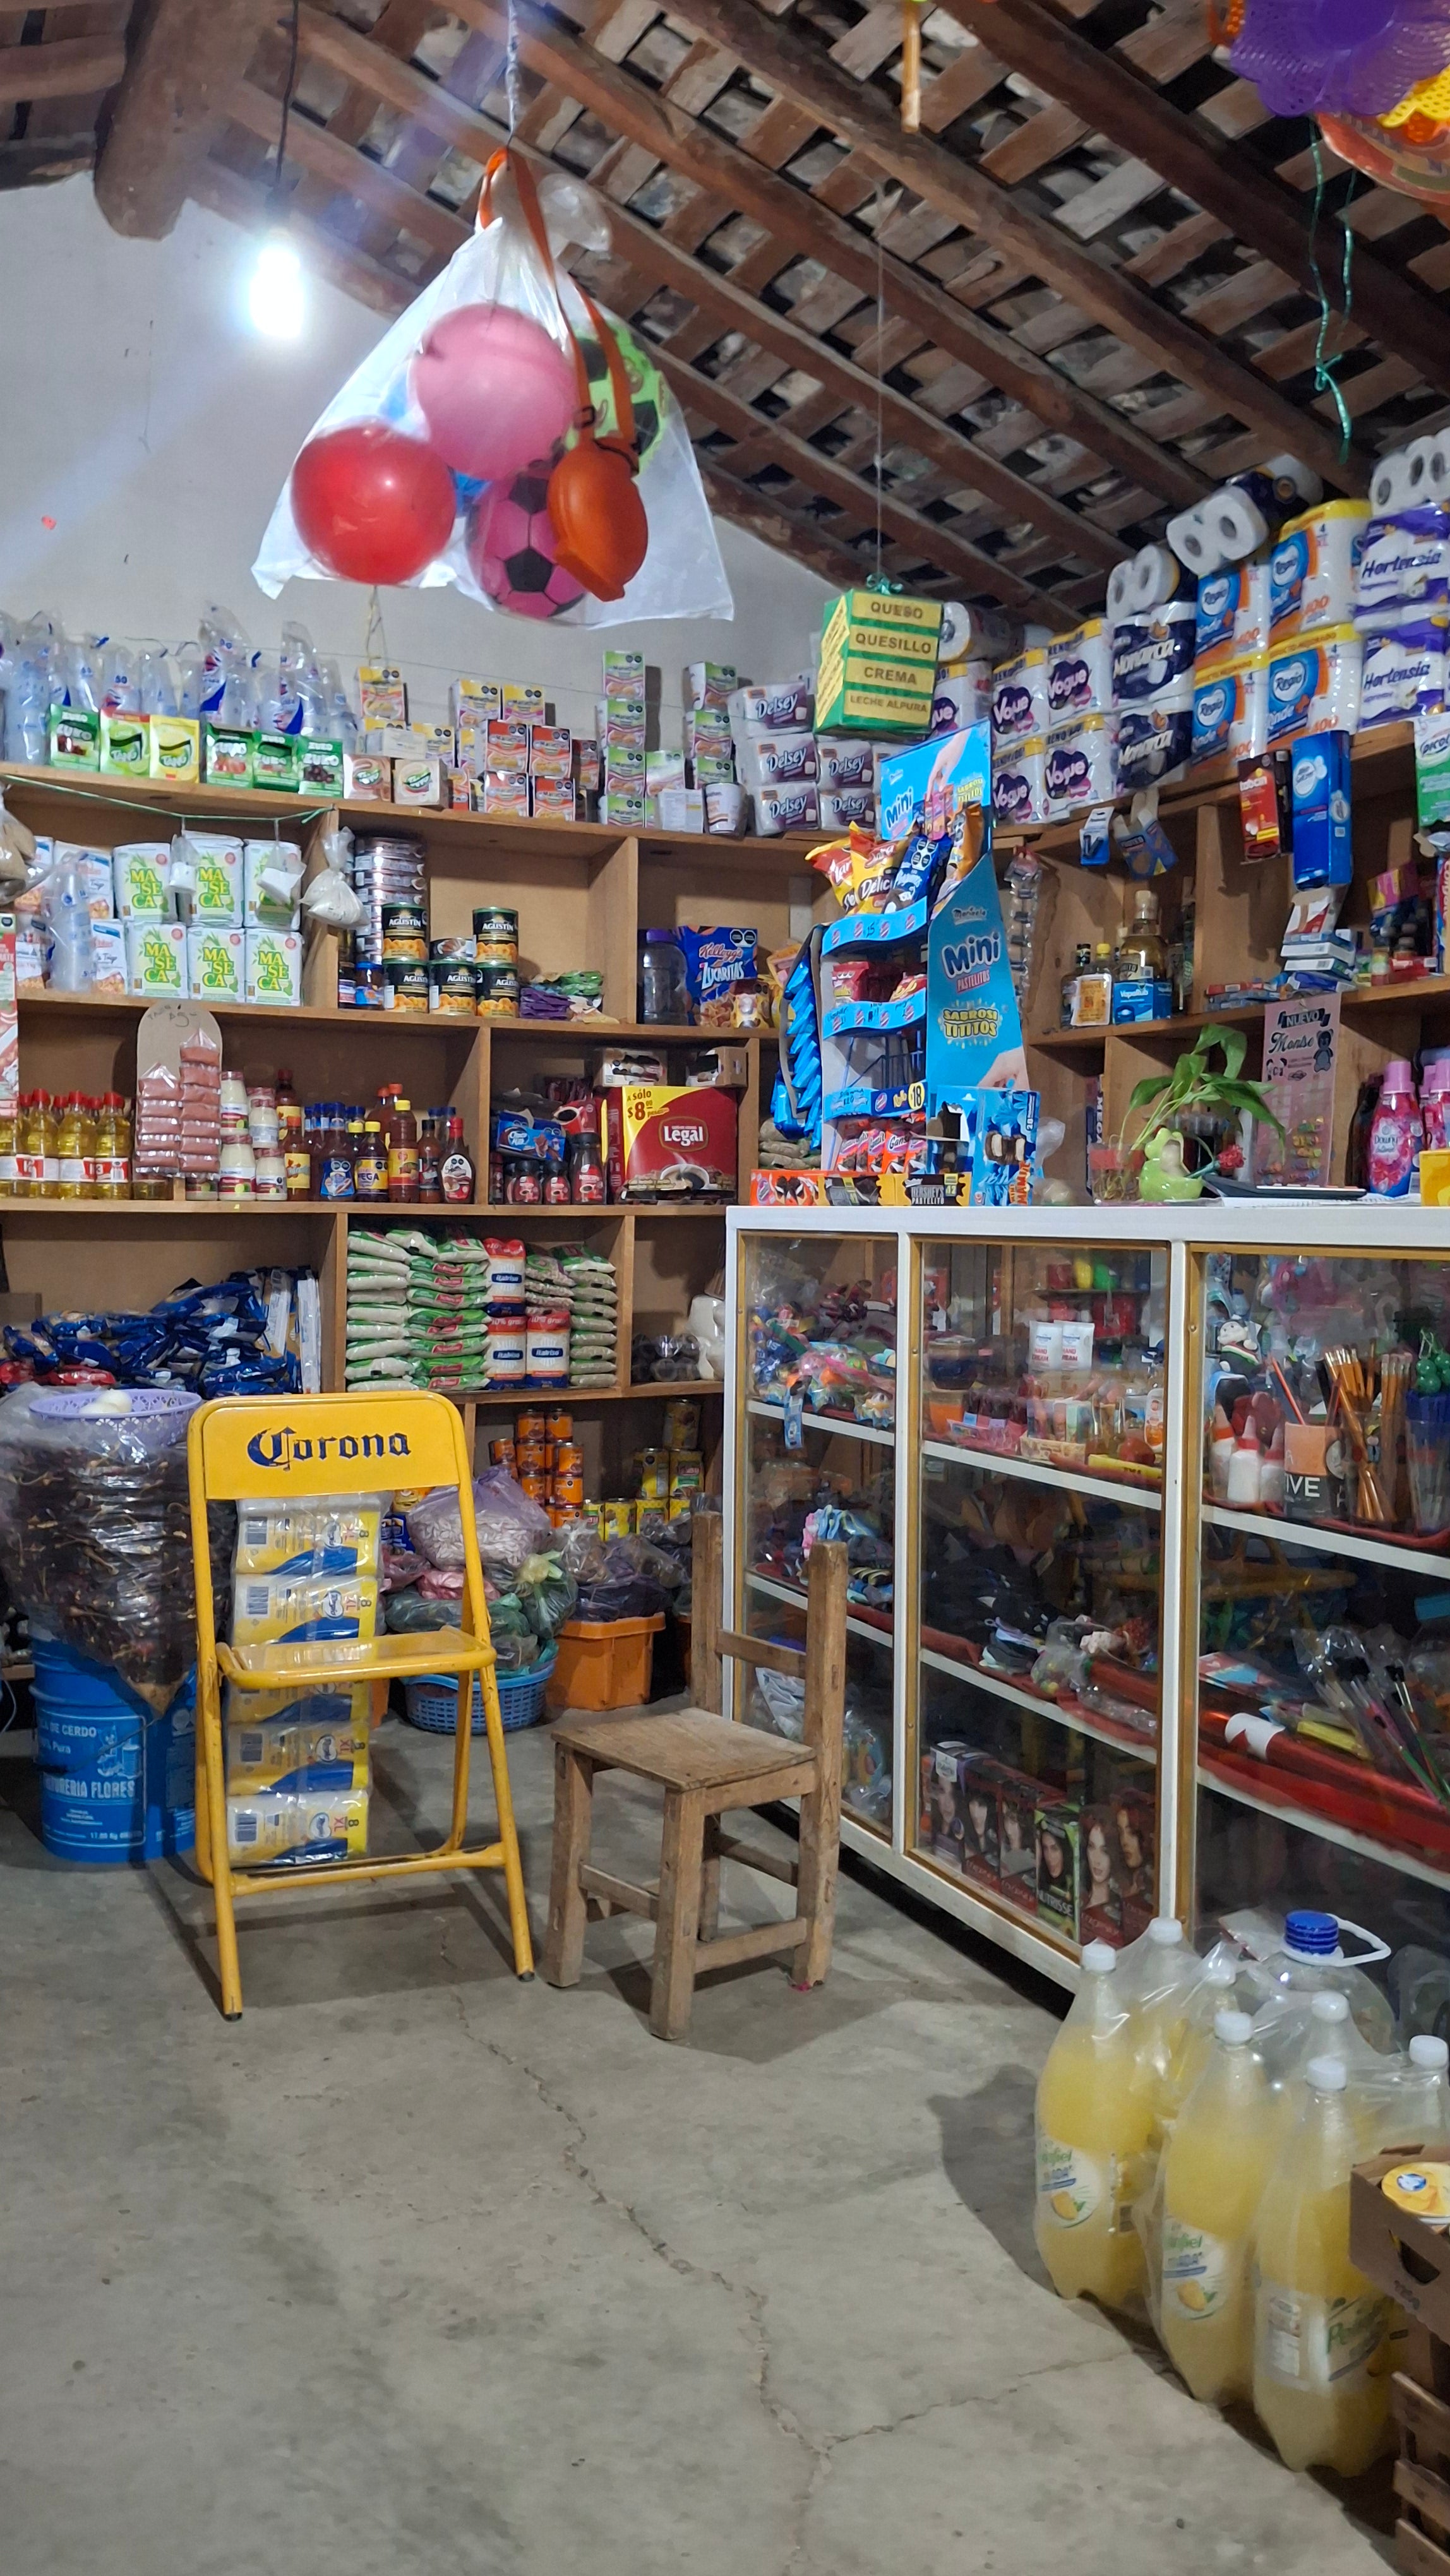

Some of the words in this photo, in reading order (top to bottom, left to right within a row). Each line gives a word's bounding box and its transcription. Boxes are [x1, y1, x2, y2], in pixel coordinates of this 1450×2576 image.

[871, 601, 923, 619] QUESO
[856, 633, 932, 654] QUESILLO
[864, 666, 918, 685] CREMA
[1048, 668, 1088, 700] Vogue
[1364, 661, 1430, 690] Hortensia
[757, 693, 798, 719] Delsey
[850, 695, 883, 707] LECHE
[887, 700, 928, 713] ALPURA
[993, 696, 1029, 725] Voue
[767, 747, 806, 773] Delsey
[829, 755, 865, 776] Delsey
[770, 795, 807, 819] Delsey
[832, 796, 868, 813] Delsey
[885, 786, 914, 831] Mini
[130, 868, 157, 883] MA
[198, 866, 225, 882] MA
[141, 881, 162, 895] SE
[209, 880, 230, 895] SE
[131, 893, 158, 909] CA
[198, 893, 224, 908] CA
[145, 942, 171, 957] MA
[202, 946, 229, 962] MA
[258, 950, 284, 966] MA
[699, 943, 743, 963] Kellogg's
[942, 931, 1000, 979] Mini
[154, 956, 177, 970] SE
[213, 960, 235, 975] SE
[267, 964, 289, 979] SE
[144, 968, 170, 983] CA
[202, 972, 227, 987] CA
[257, 976, 282, 991] CA
[700, 960, 745, 990] ZUCARITAS
[957, 970, 990, 991] PASTELITOS
[943, 1008, 998, 1022] SABROSI
[1286, 1010, 1319, 1027] NUEVO
[944, 1020, 998, 1038] TITITOS
[632, 1088, 652, 1100] sólo
[912, 1085, 922, 1107] 18
[664, 1125, 704, 1147] Legal
[1374, 1135, 1398, 1147] Downy
[246, 1425, 412, 1472] Corona
[359, 1529, 369, 1539] 8
[361, 1598, 371, 1607] 8
[61, 1724, 97, 1738] CERDO
[91, 1779, 136, 1799] FLORES
[348, 1818, 359, 1828] 8
